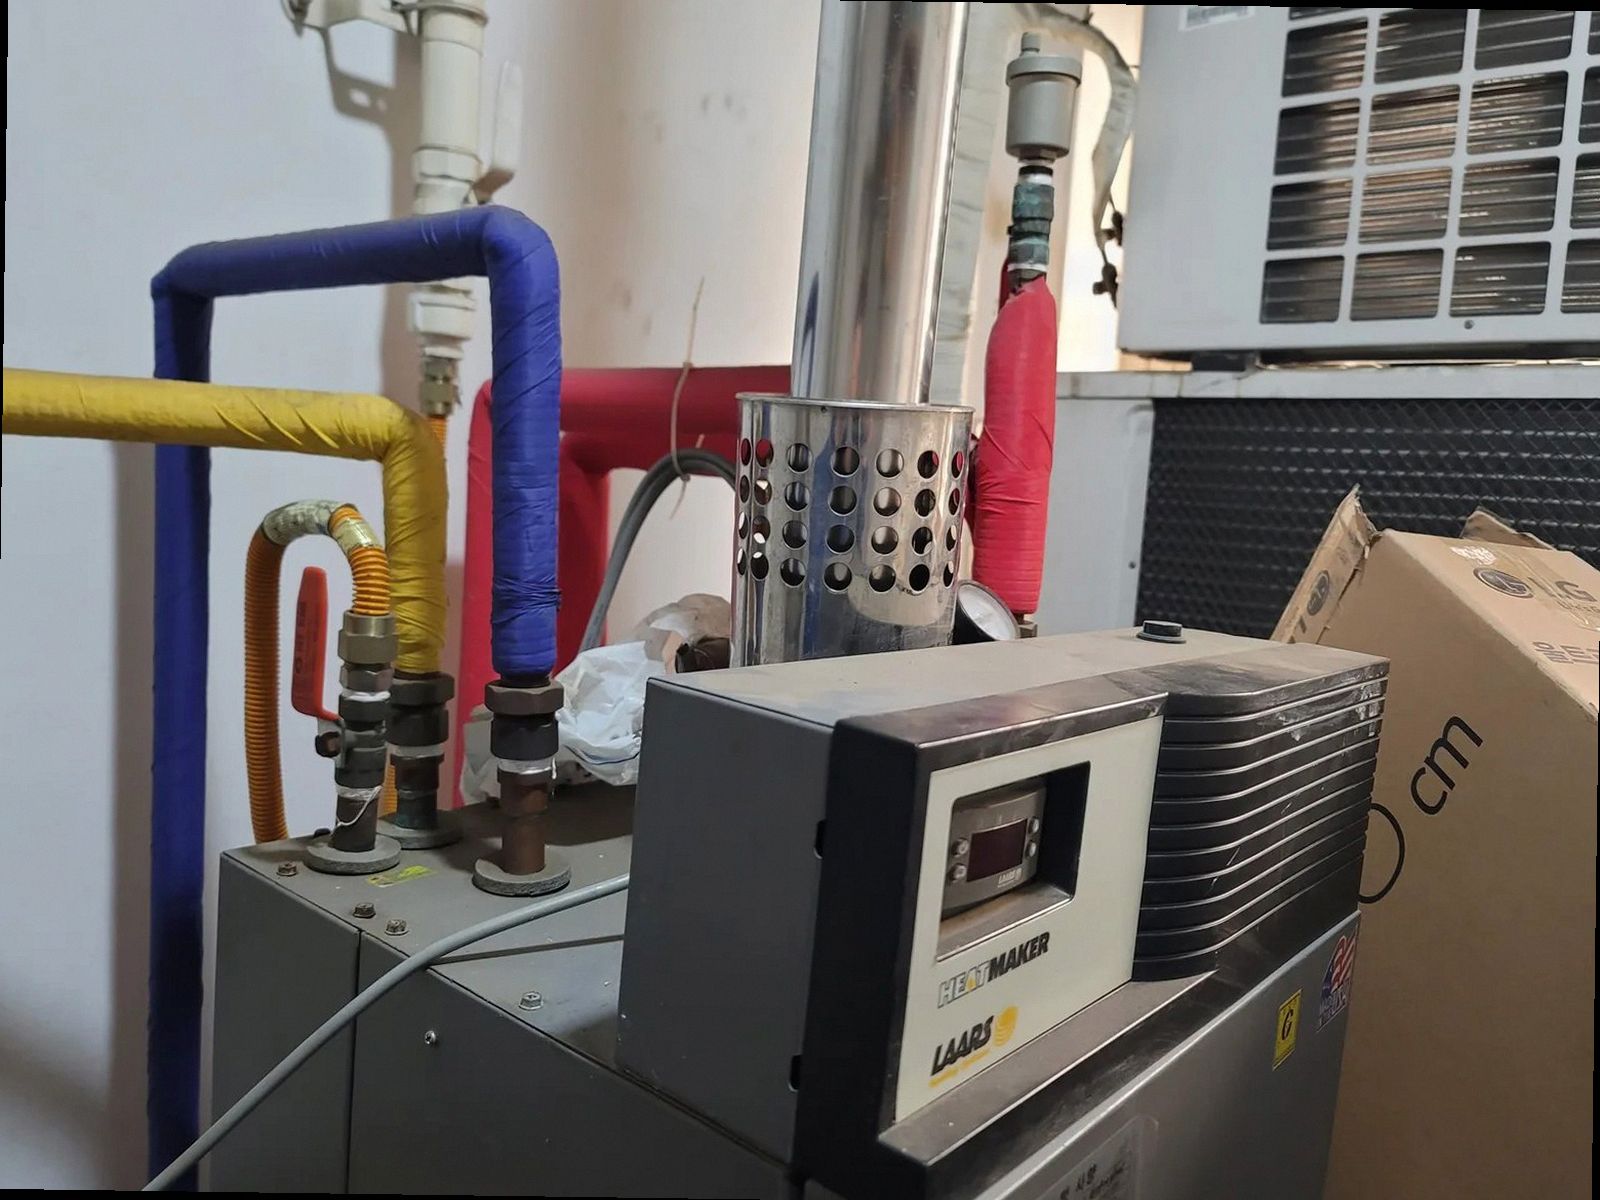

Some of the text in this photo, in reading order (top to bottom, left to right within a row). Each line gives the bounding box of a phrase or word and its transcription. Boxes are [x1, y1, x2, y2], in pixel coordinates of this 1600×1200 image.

[1410, 715, 1484, 815] cm
[937, 931, 1051, 1009] HEATMAKER
[930, 1014, 995, 1077] LAARS
